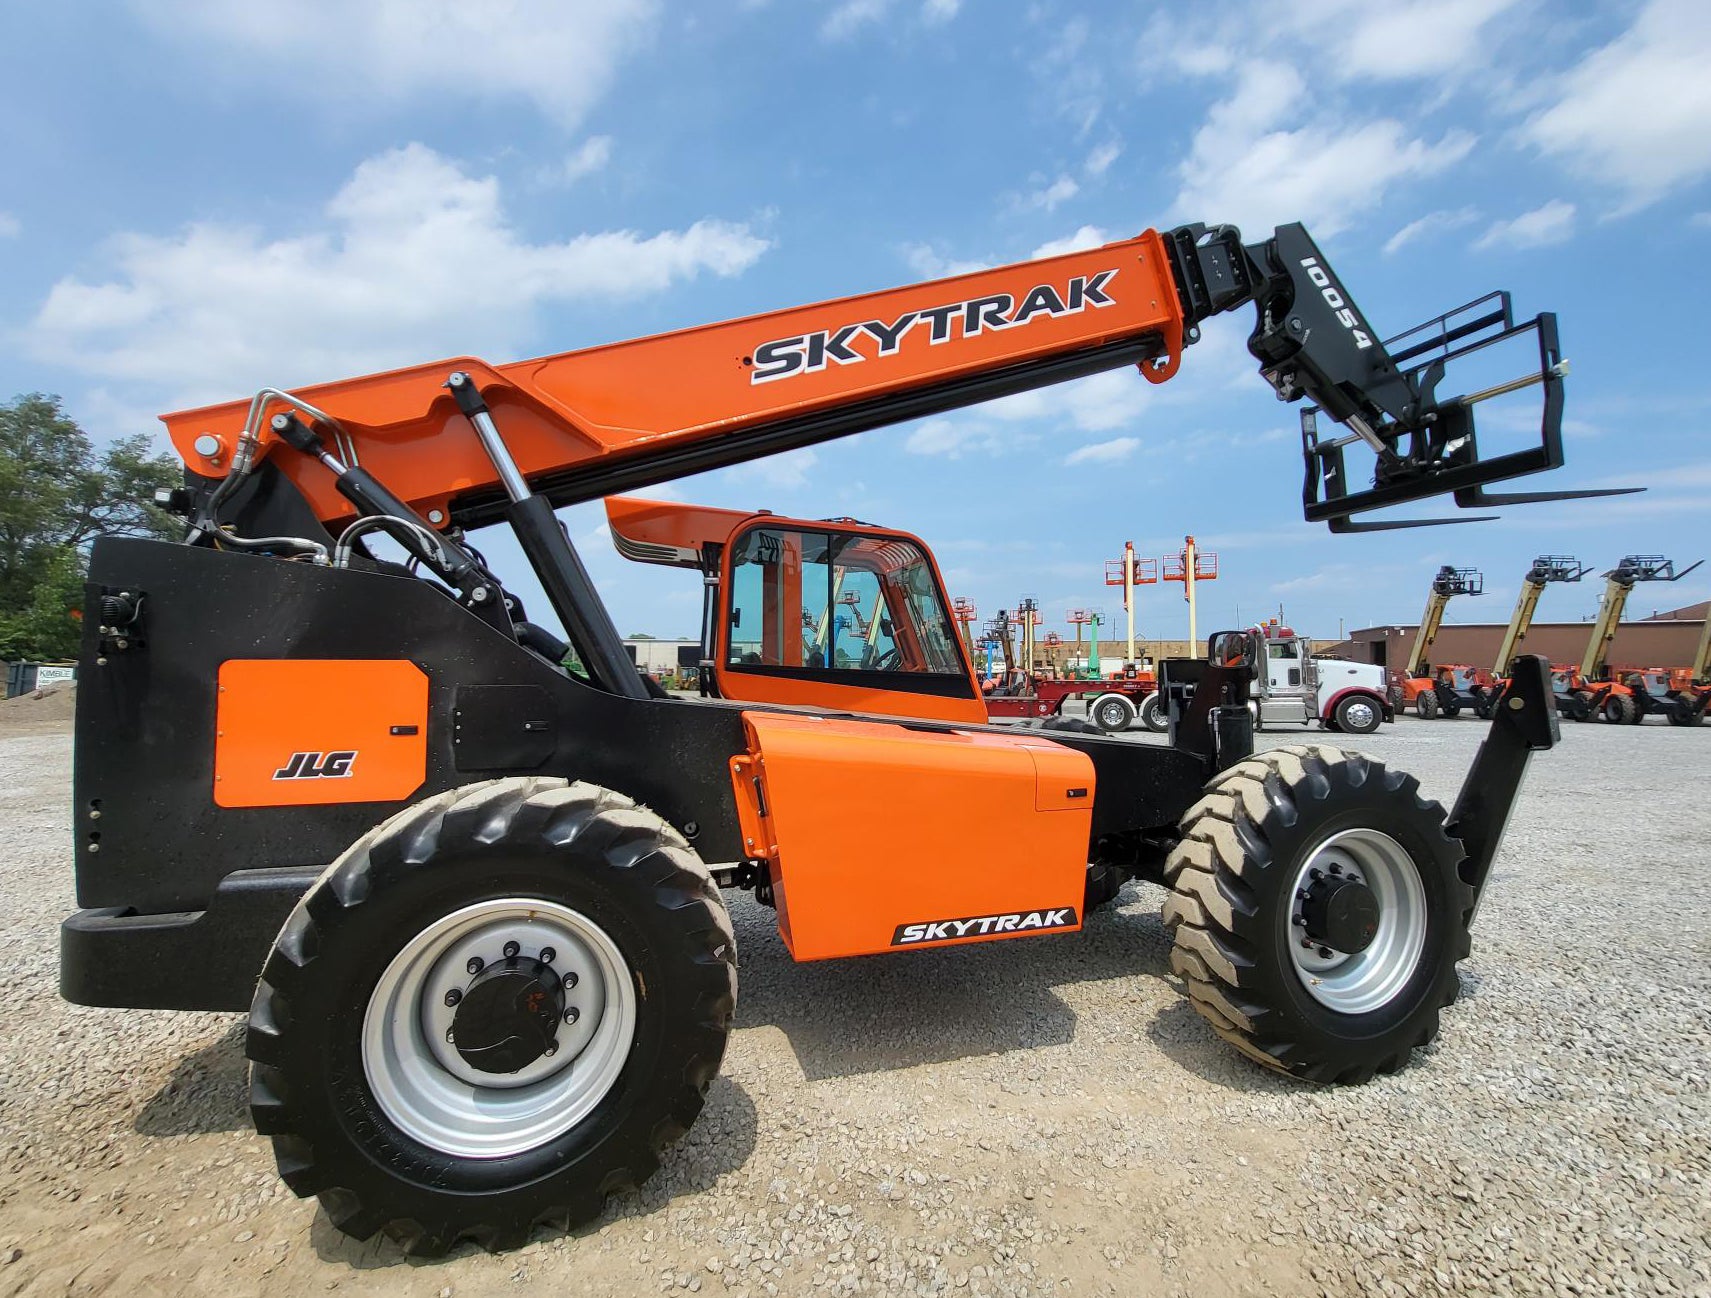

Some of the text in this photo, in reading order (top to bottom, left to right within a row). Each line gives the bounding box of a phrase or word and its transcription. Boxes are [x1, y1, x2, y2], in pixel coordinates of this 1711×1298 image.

[751, 268, 1119, 385] SKYTRAK
[1300, 257, 1373, 349] 10054
[272, 750, 358, 780] JLG
[900, 908, 1069, 943] SKYTRAK
